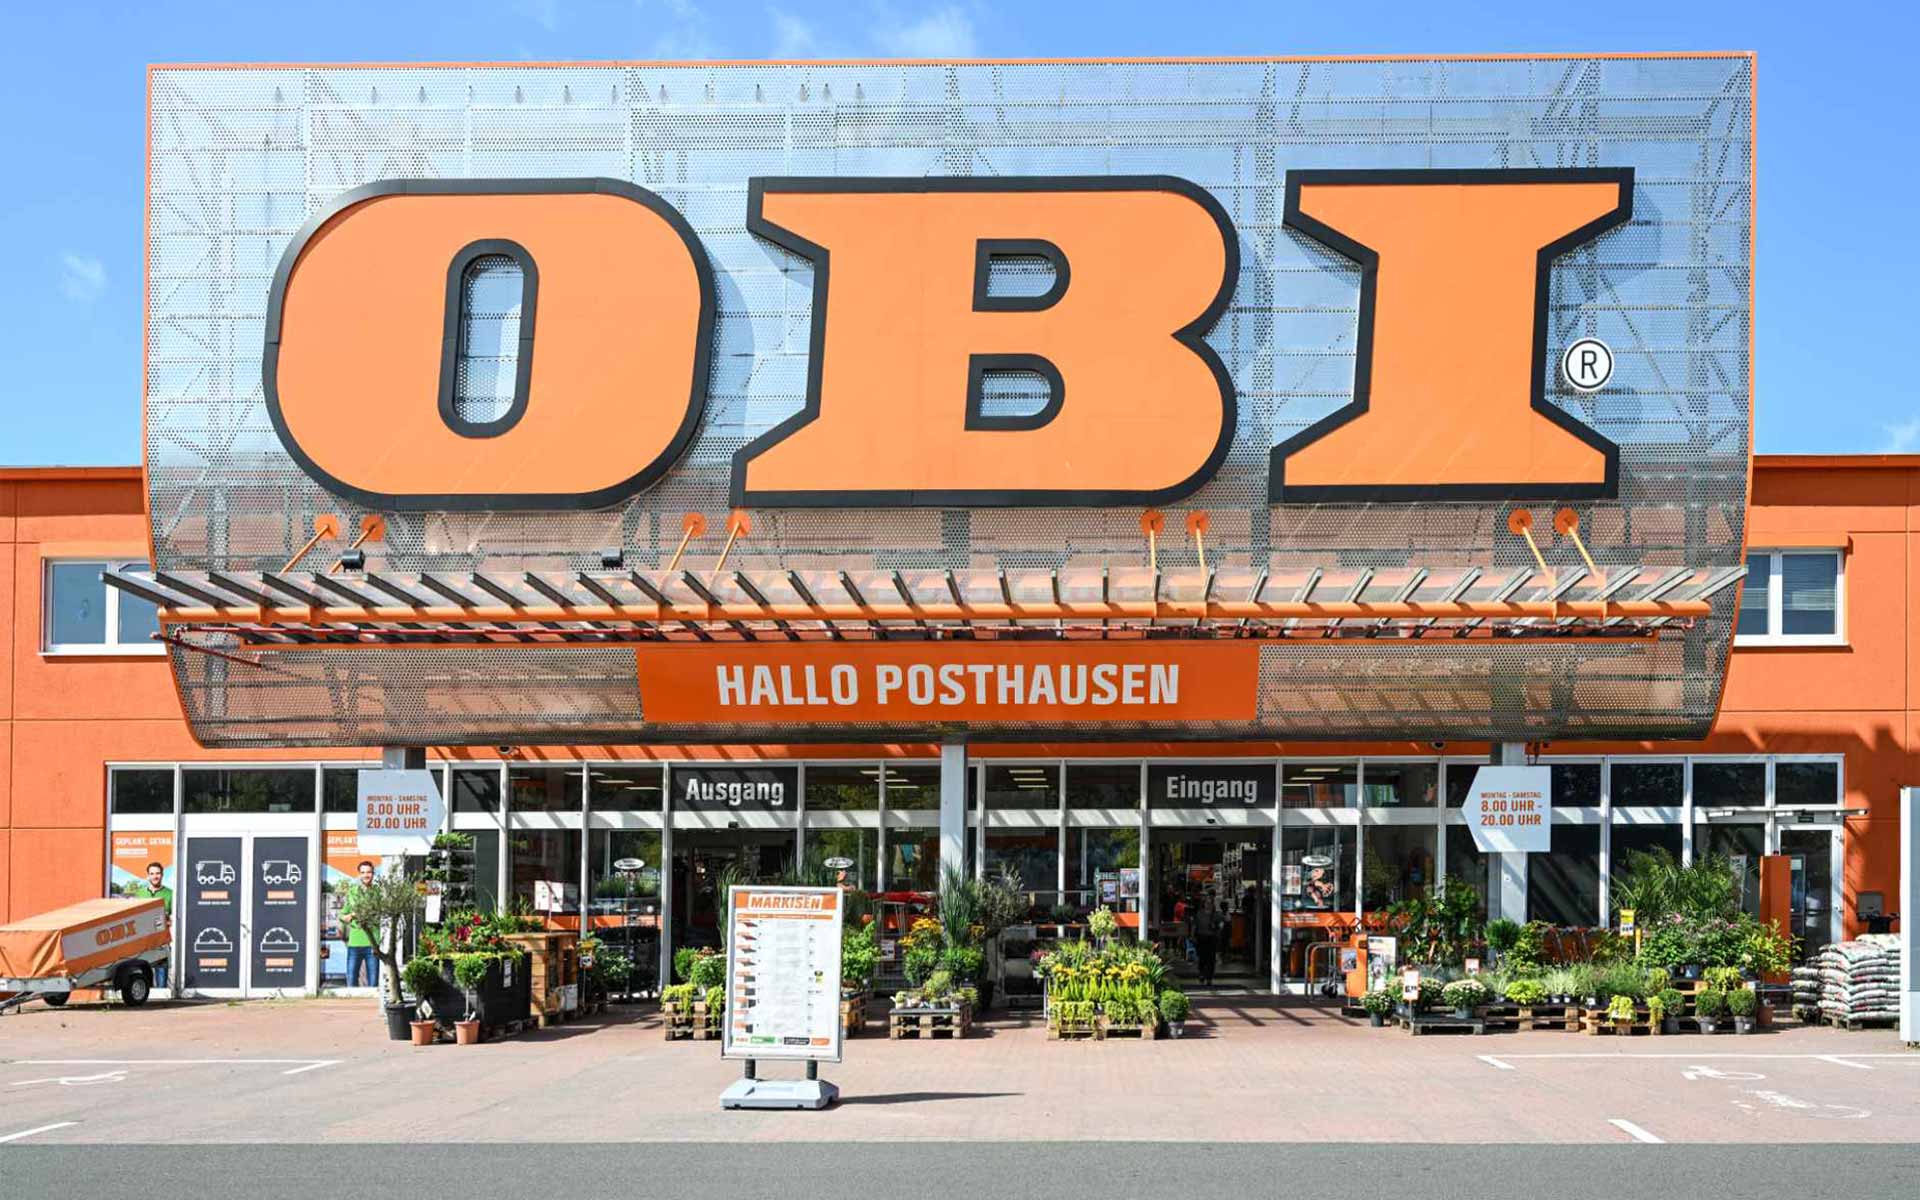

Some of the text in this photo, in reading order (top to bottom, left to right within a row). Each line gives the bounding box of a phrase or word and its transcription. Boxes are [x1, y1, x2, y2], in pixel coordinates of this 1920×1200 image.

[263, 167, 1634, 509] OBI
[716, 663, 1180, 706] HALLO POSTHAUSEN
[685, 778, 784, 806] Ausgang
[1166, 774, 1258, 803] Eingang
[367, 803, 393, 815] 8.00
[397, 803, 420, 815] UHR
[1481, 800, 1507, 812] 8.00
[1511, 800, 1535, 812] UHR
[367, 817, 427, 829] 20.00 UHR
[1481, 814, 1542, 826] 20.00 UHR
[750, 895, 821, 910] MARKISEN
[95, 919, 137, 946] OBI
